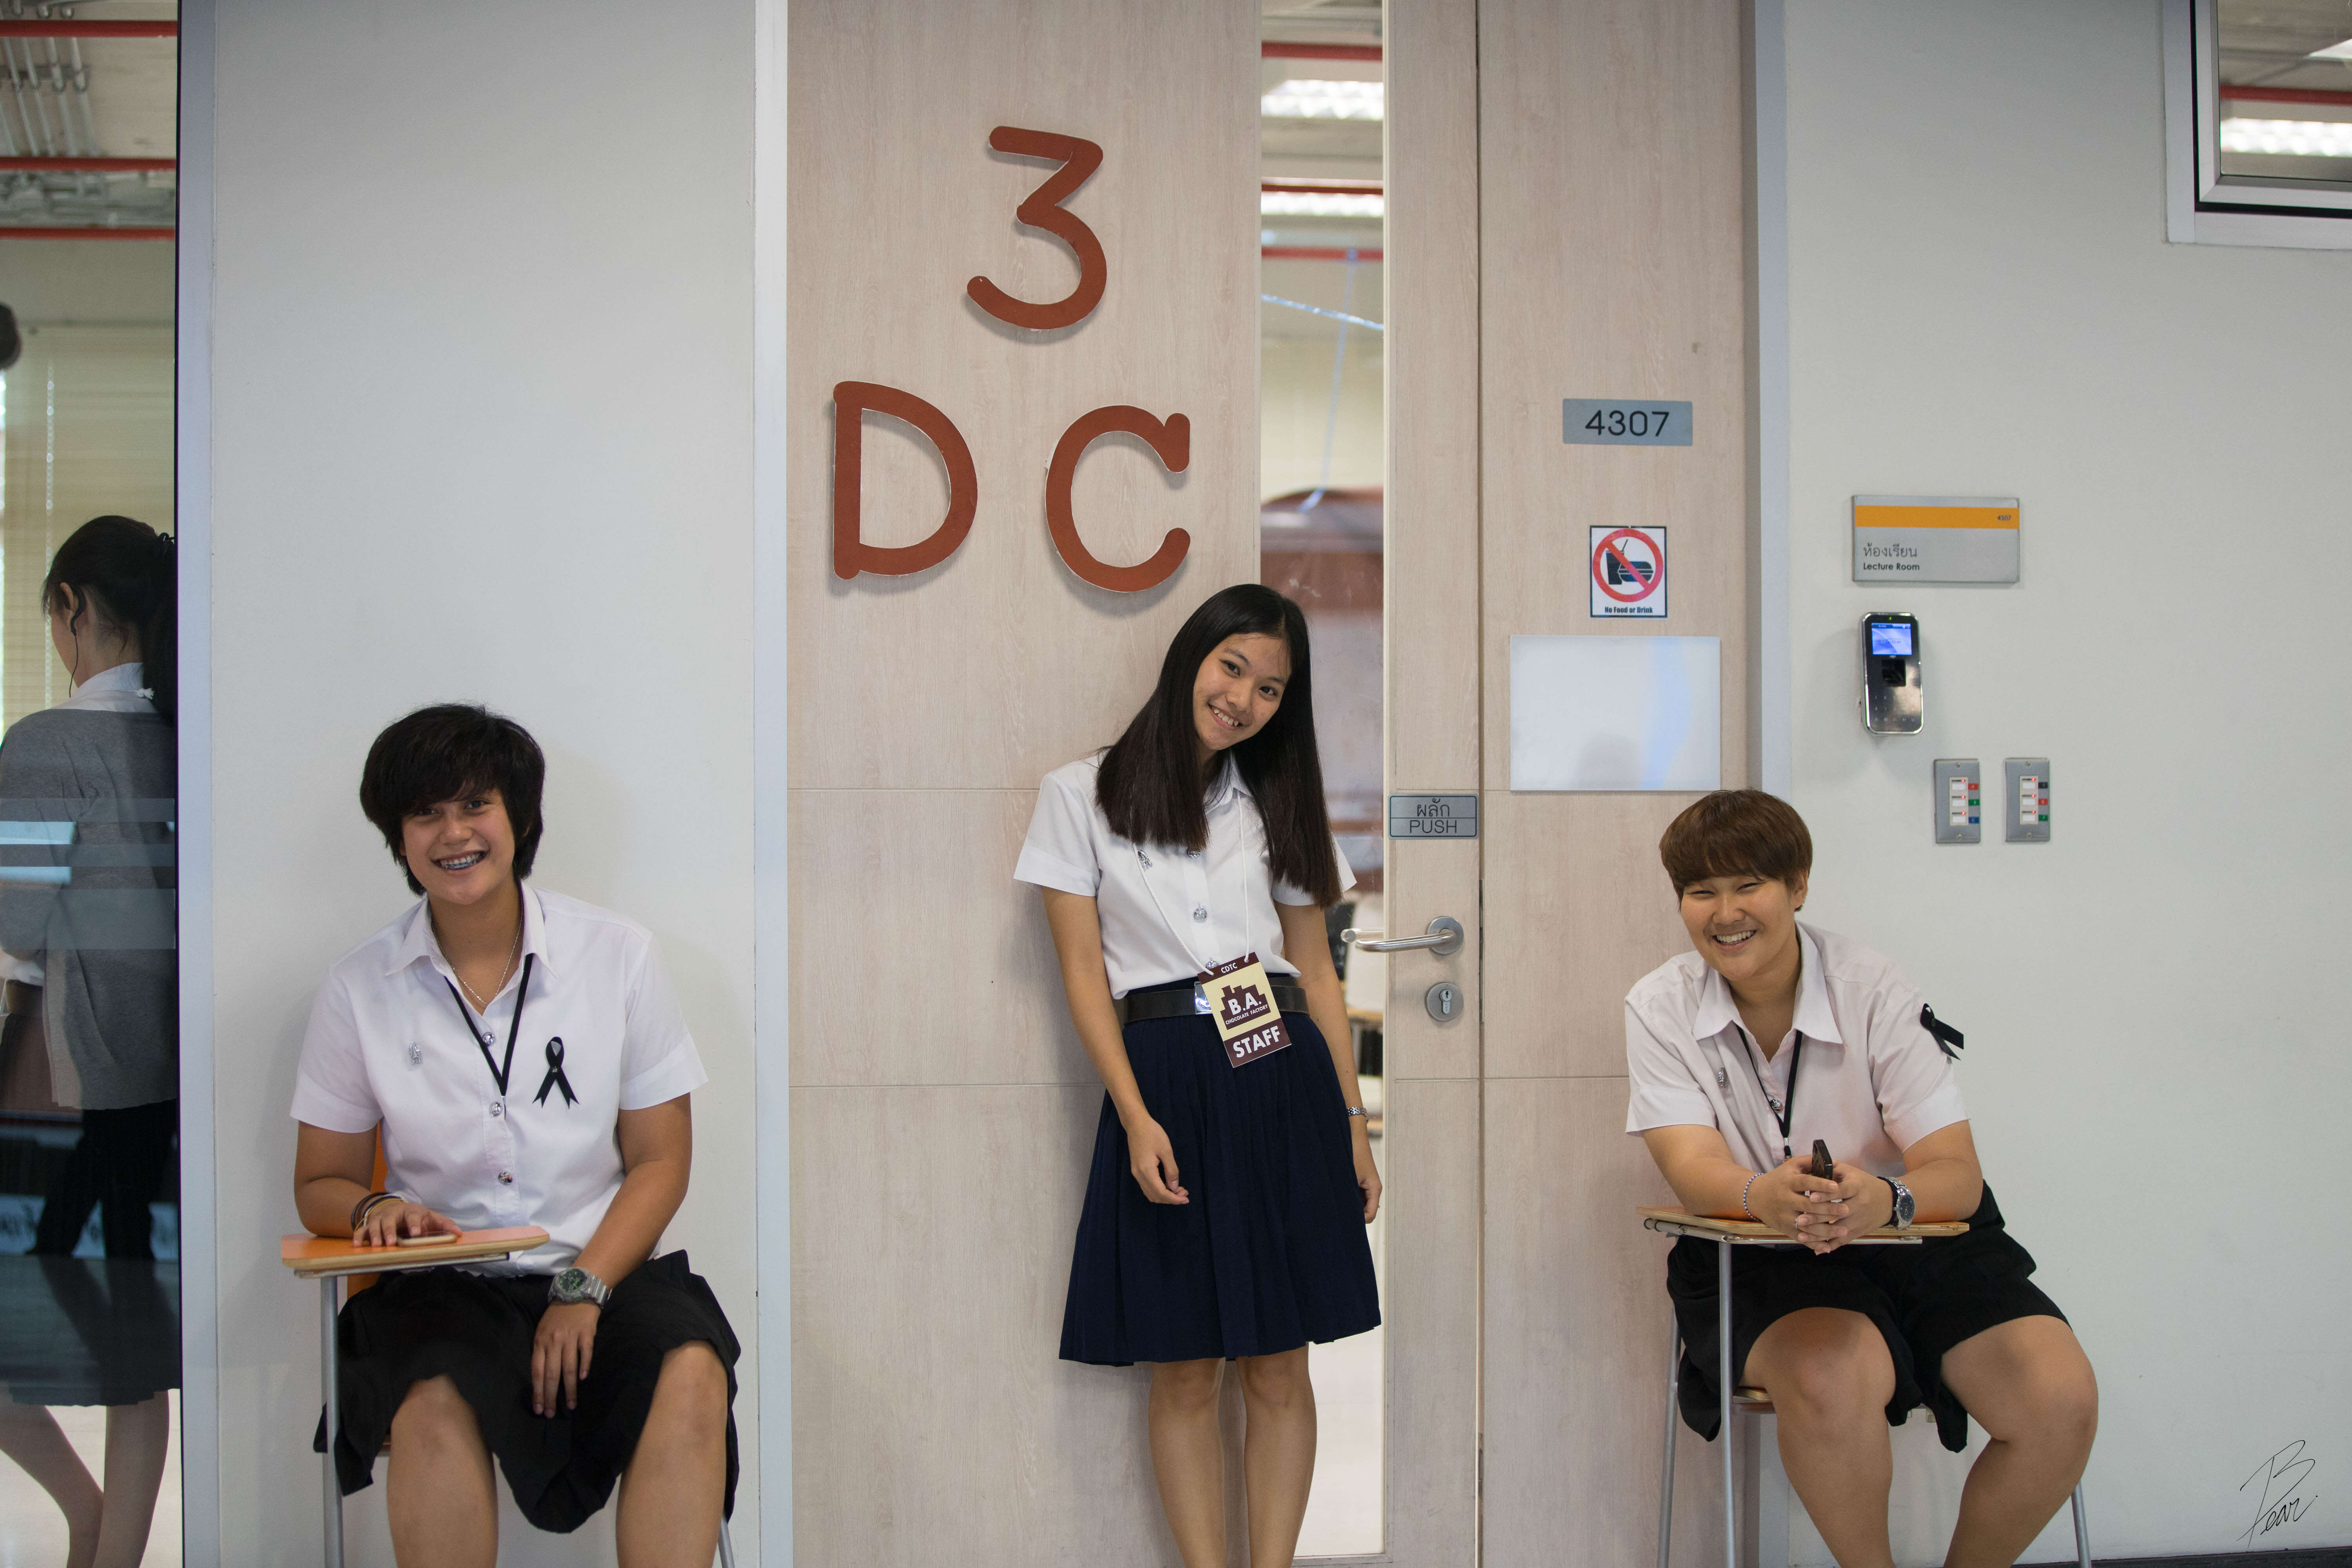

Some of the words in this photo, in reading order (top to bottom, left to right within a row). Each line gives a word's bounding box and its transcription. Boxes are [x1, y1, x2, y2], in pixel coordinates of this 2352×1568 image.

[967, 125, 1107, 330] 3
[1585, 410, 1670, 436] 4307
[1864, 542, 1918, 557] ห้องเรียน
[1417, 798, 1450, 817] ผลัก
[1410, 820, 1457, 833] PUSH
[1221, 962, 1238, 973] CDTC
[1227, 992, 1262, 1015] B.A.
[1225, 1012, 1249, 1025] CHOCOLATE
[1250, 1004, 1268, 1015] FACTORY
[1233, 1025, 1280, 1058] STAFF
